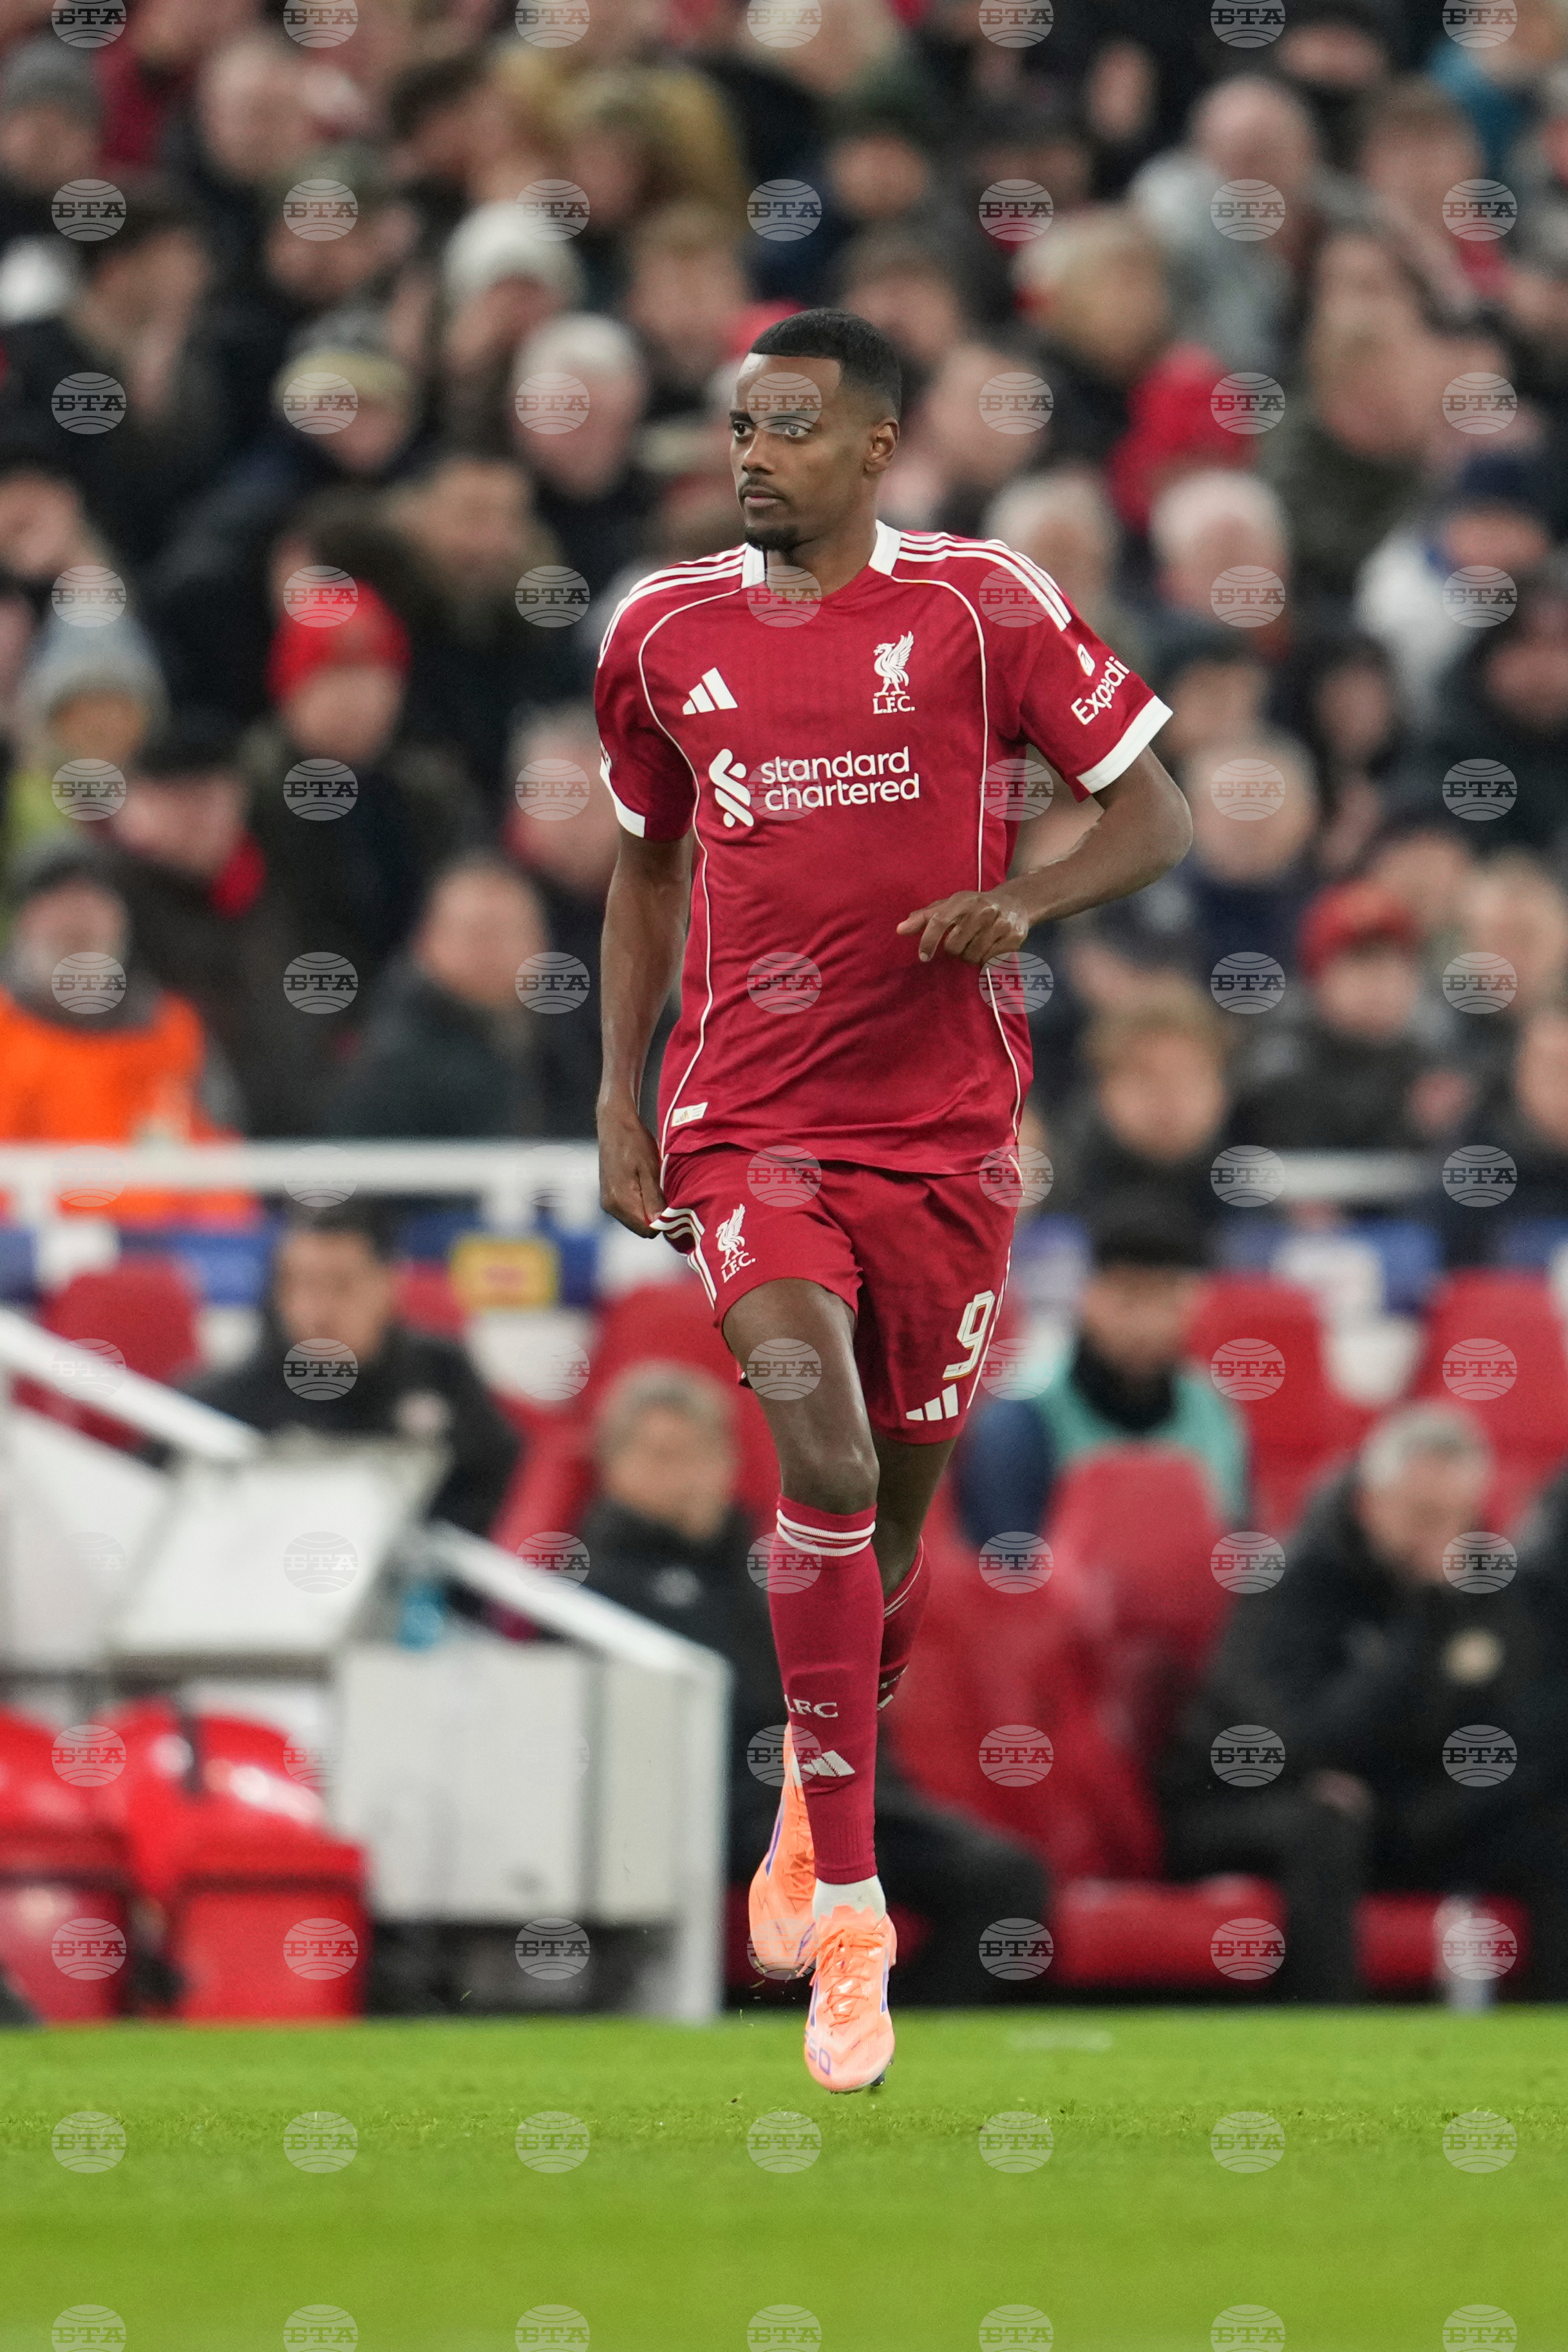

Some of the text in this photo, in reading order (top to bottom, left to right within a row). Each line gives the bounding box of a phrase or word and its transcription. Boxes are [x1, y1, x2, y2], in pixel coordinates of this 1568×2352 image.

[873, 696, 915, 714] L.F.C.
[760, 746, 910, 784] standard
[764, 773, 920, 811] chartered
[942, 1289, 996, 1380] 9
